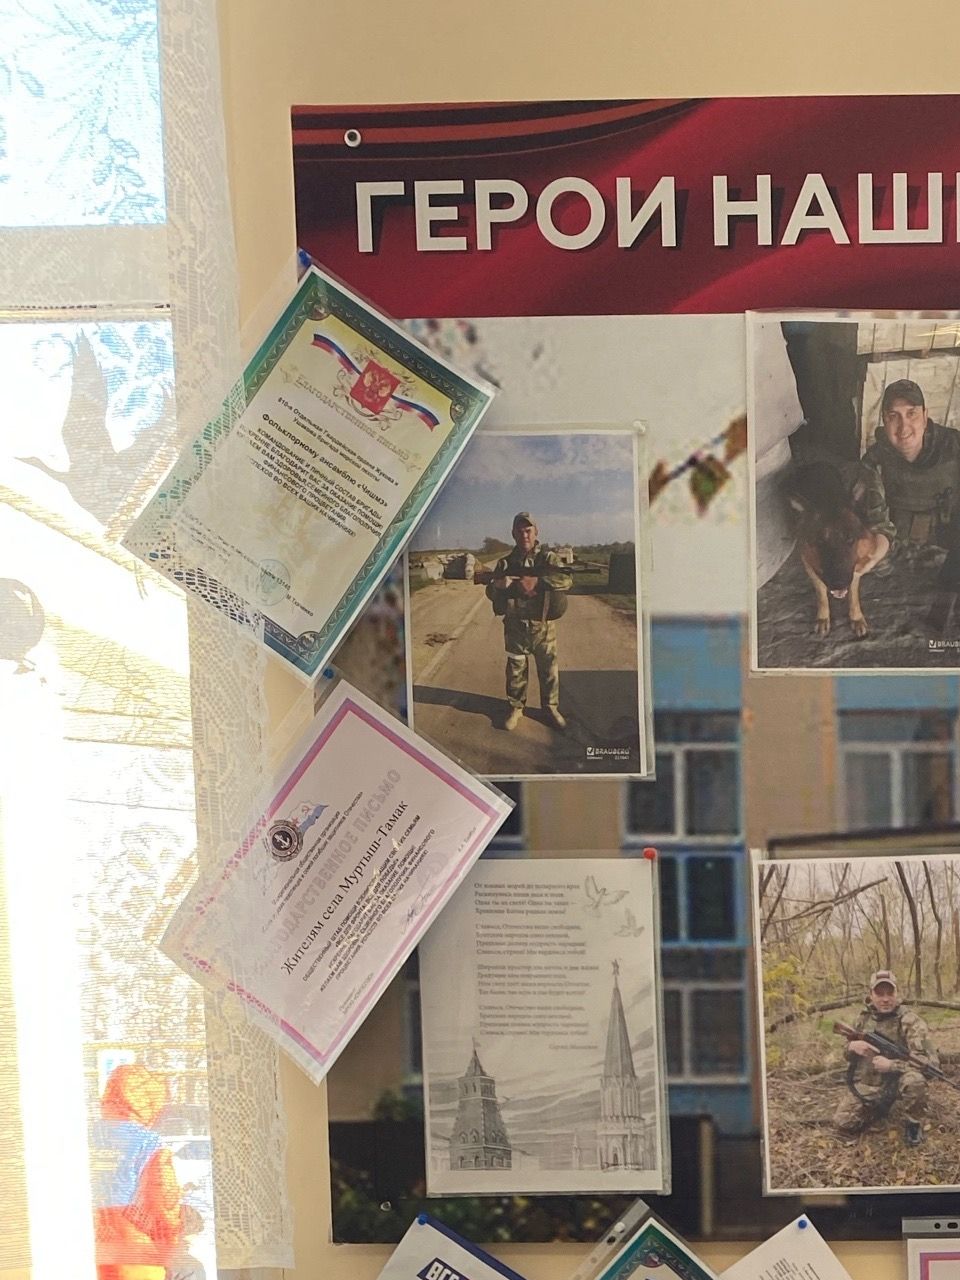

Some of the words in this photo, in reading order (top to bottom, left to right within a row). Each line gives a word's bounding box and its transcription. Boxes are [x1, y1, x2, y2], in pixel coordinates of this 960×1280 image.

[356, 176, 677, 253] ГЕРОИ
[256, 427, 305, 464] КОМАНДОВАНИЕ
[333, 483, 356, 501] СОСТАВ
[260, 412, 319, 459] Фольклорному
[318, 455, 358, 486] ансамблю
[355, 481, 390, 508] «Чишмэ»
[270, 446, 309, 477] БЛАГОДАРИТ
[351, 767, 402, 832] ПИСЬМО
[280, 918, 325, 976] Жителям
[320, 892, 344, 921] села
[338, 798, 409, 894] Муртыш-Тамак
